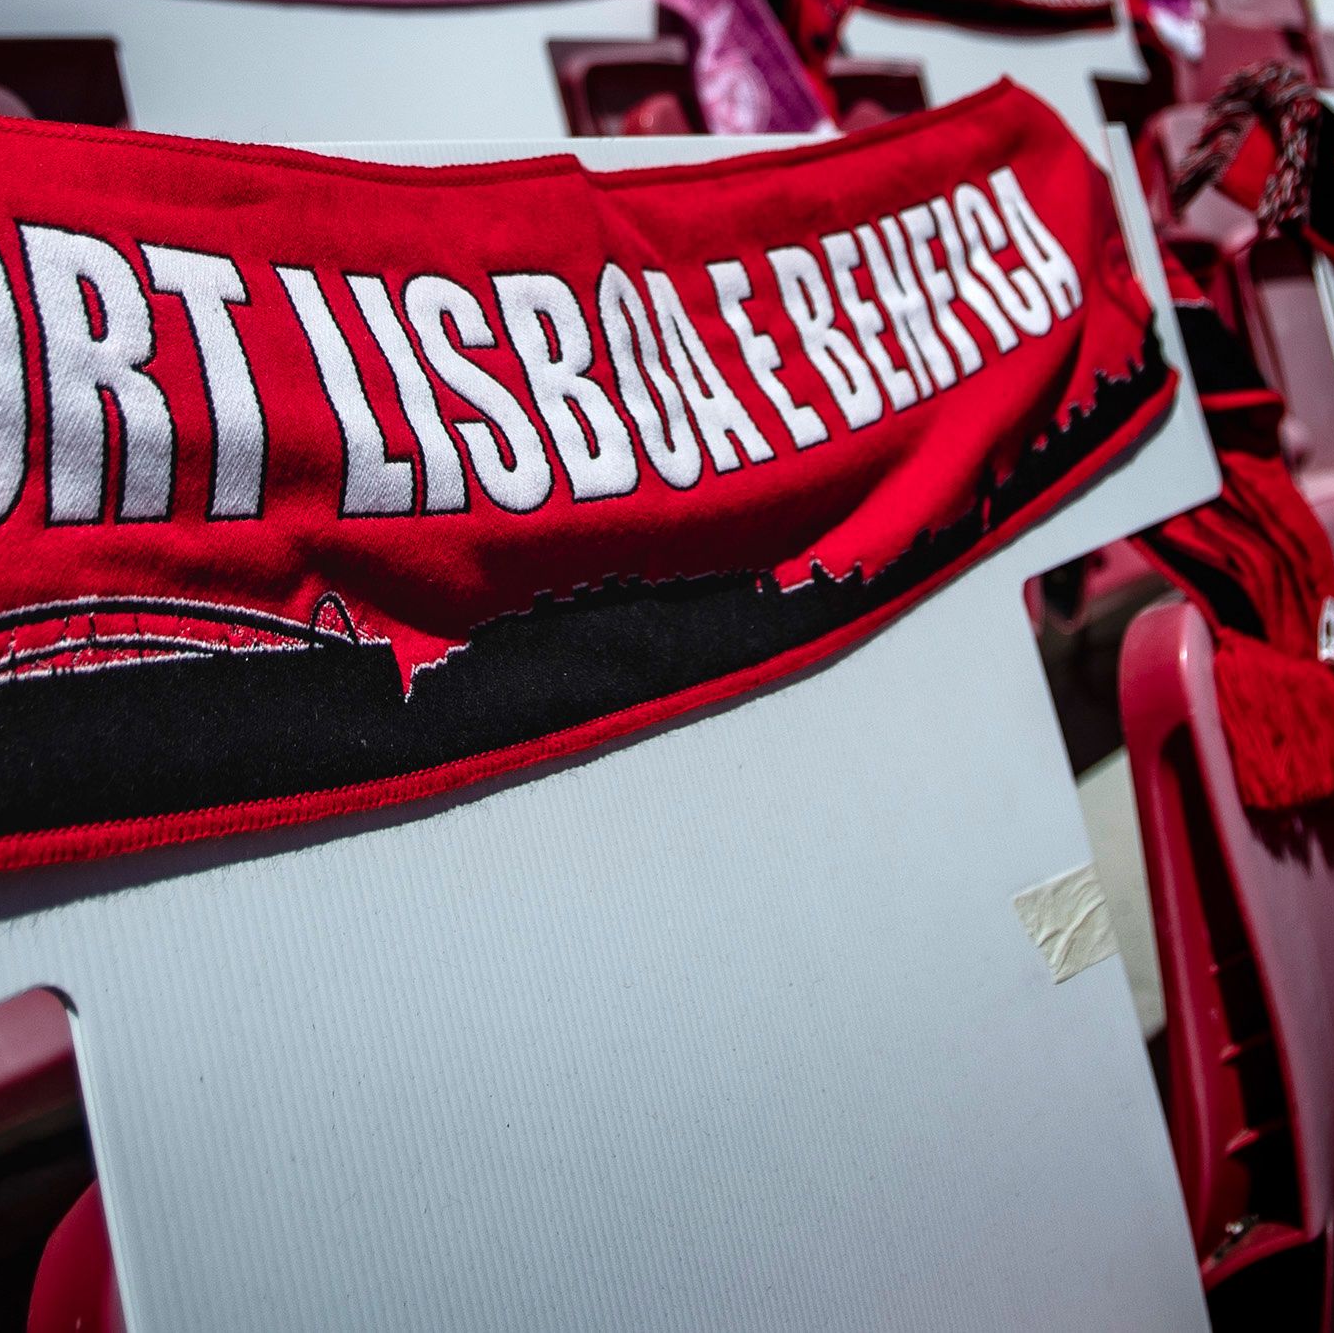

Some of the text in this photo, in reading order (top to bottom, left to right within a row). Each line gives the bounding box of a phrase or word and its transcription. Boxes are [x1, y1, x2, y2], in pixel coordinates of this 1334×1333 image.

[273, 262, 776, 517] LISBOA
[705, 257, 831, 452] E
[765, 163, 1085, 432] BENFICA
